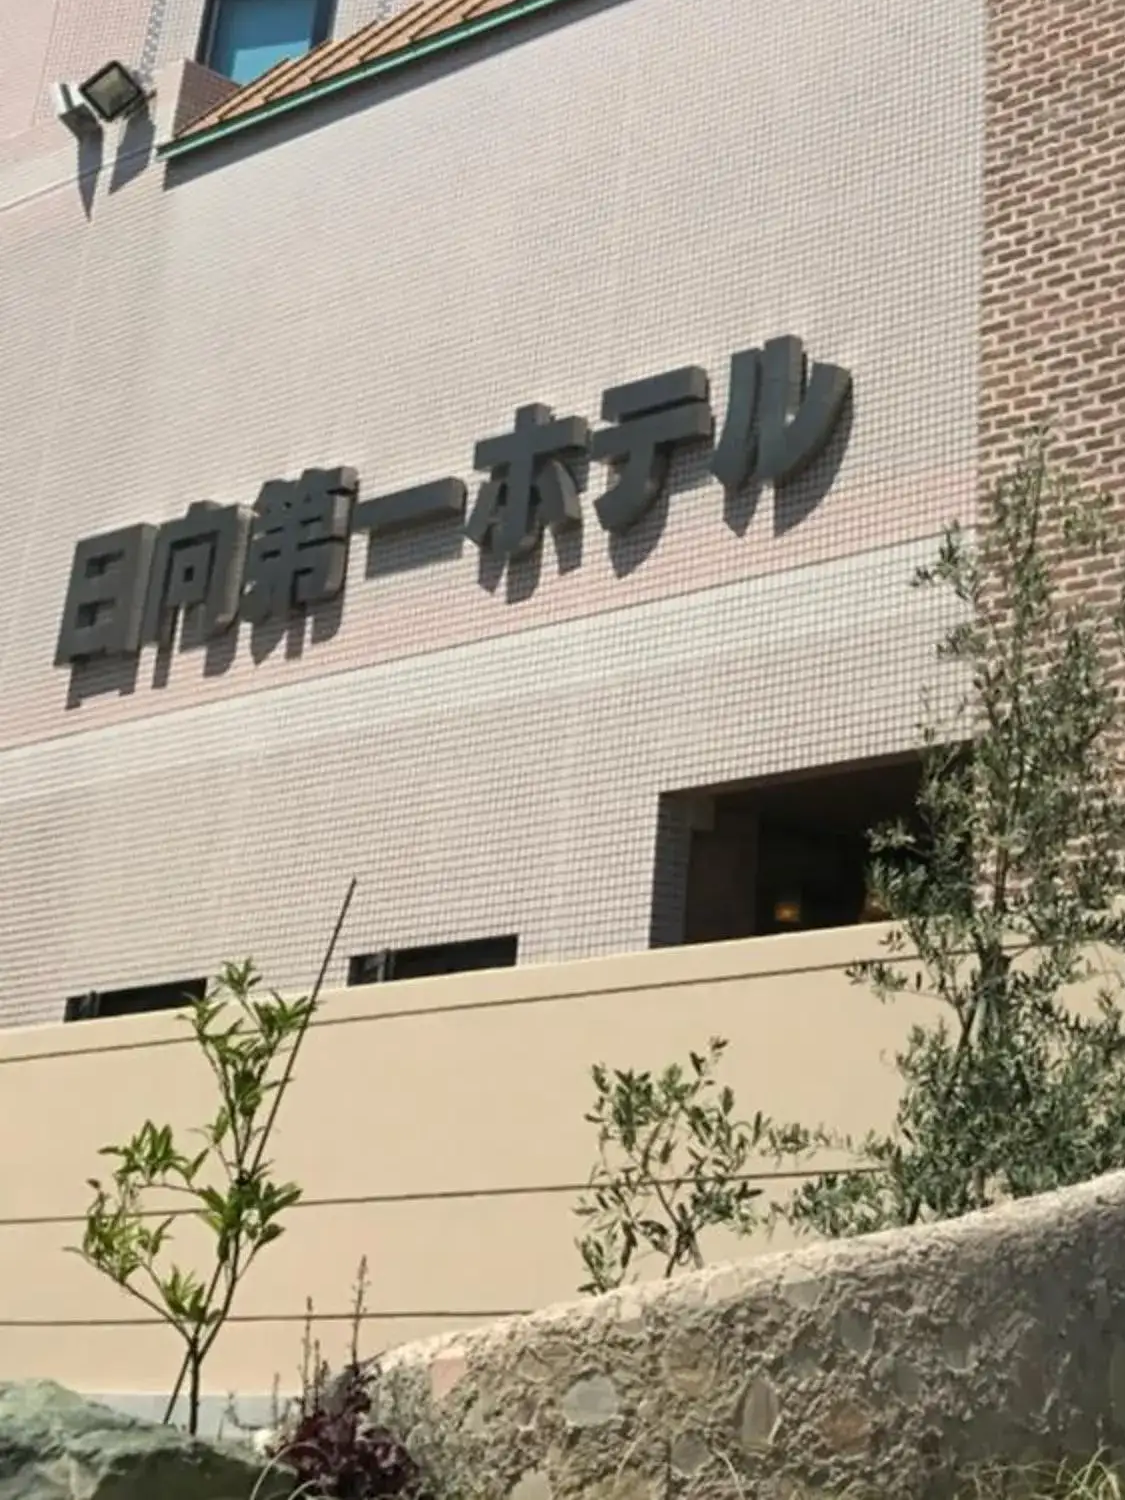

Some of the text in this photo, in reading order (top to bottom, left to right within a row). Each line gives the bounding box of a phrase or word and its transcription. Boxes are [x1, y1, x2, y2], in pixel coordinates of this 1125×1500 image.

[53, 333, 852, 668] 日向第一ホテル
